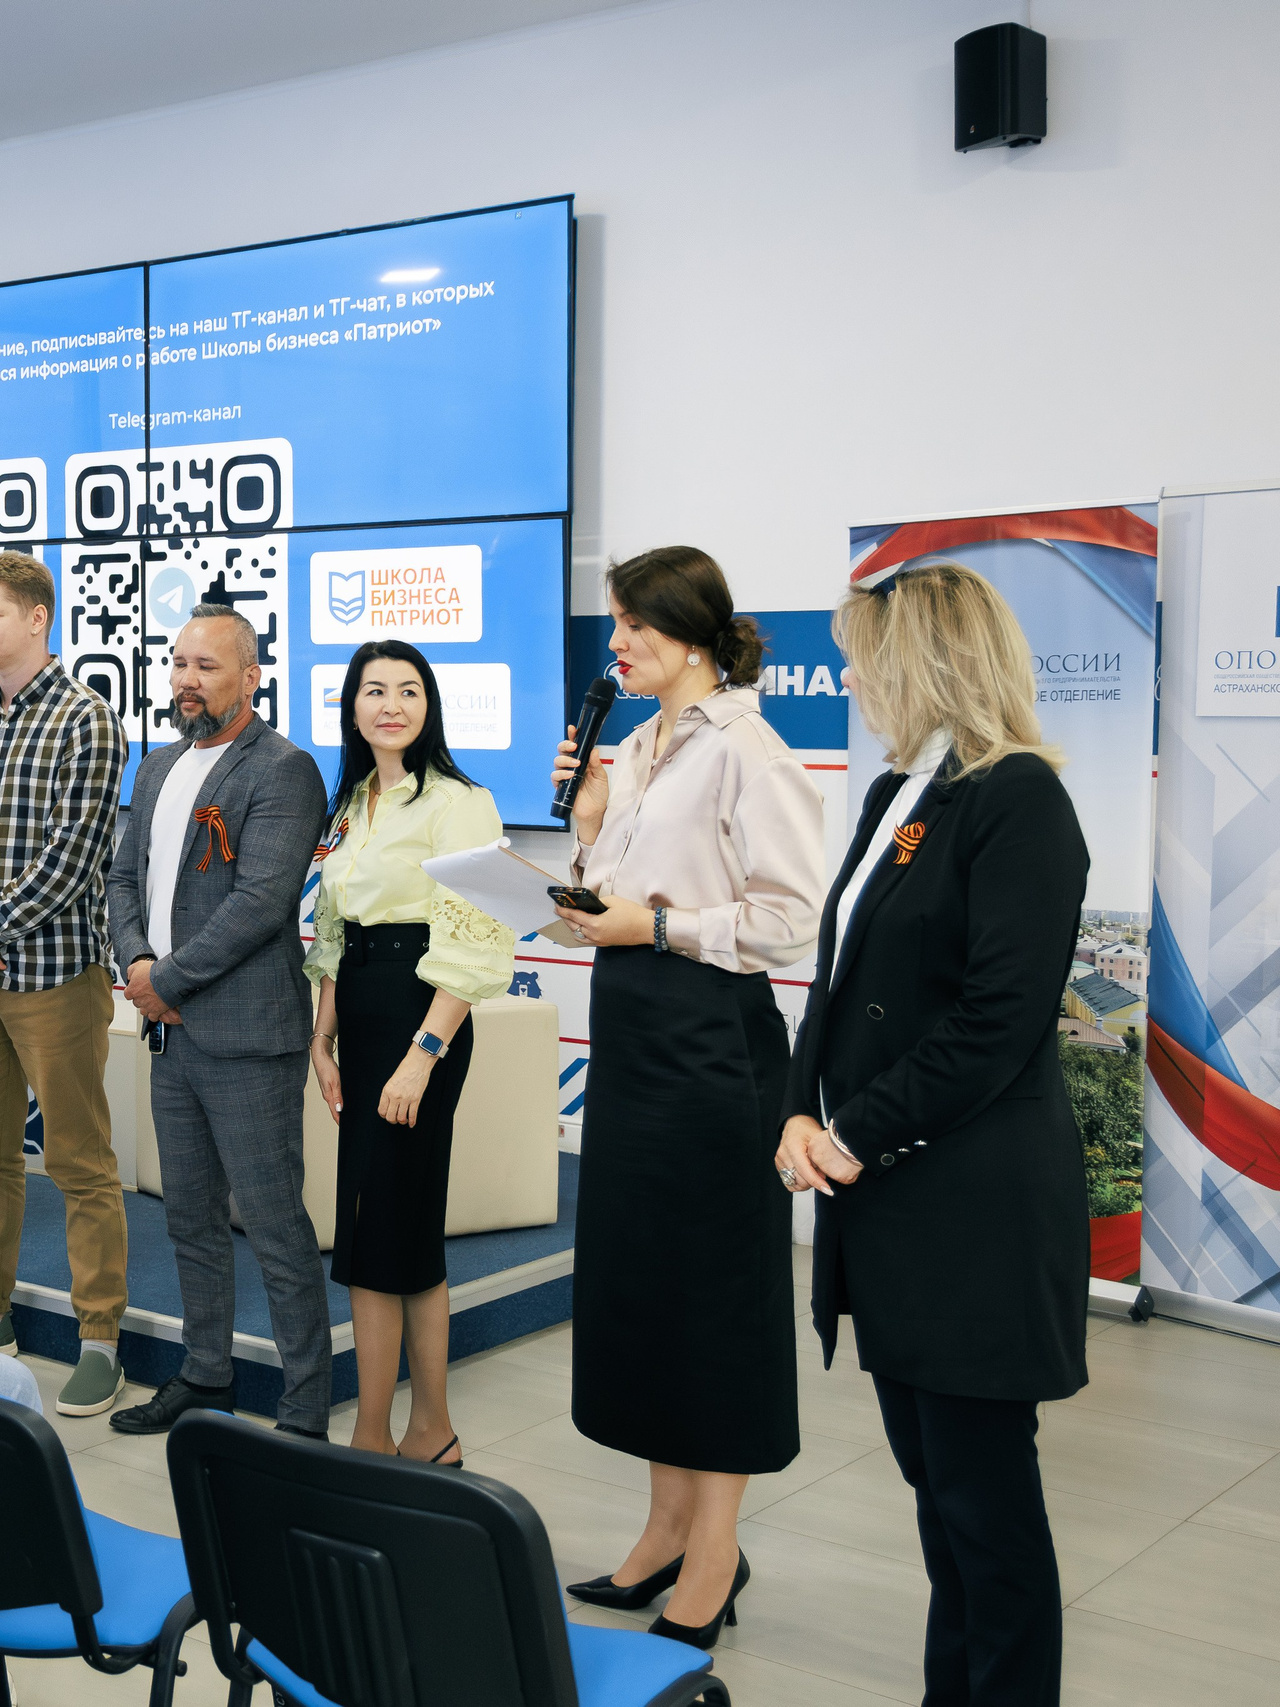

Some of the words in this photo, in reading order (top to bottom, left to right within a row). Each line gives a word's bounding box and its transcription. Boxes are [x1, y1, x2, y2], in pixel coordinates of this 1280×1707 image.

[31, 325, 164, 354] подписывайтесь
[169, 322, 189, 338] на
[193, 316, 228, 335] наш
[231, 305, 309, 330] ТГ-канал
[313, 303, 325, 320] и
[328, 294, 391, 317] ТГ-чат,
[395, 293, 407, 309] в
[411, 280, 495, 306] которых
[20, 355, 118, 381] информация
[121, 354, 132, 368] о
[135, 345, 198, 371] работе
[201, 339, 262, 360] Школы
[265, 331, 340, 352] бизнеса
[343, 317, 442, 343] «Патриот»
[371, 567, 446, 586] ШКОЛА
[371, 587, 461, 606] БИЗНЕСА
[371, 608, 464, 627] ПАТРИОТ
[442, 695, 497, 710] ССИИ
[1050, 688, 1121, 704] ОТДЕЛЕНИЕ
